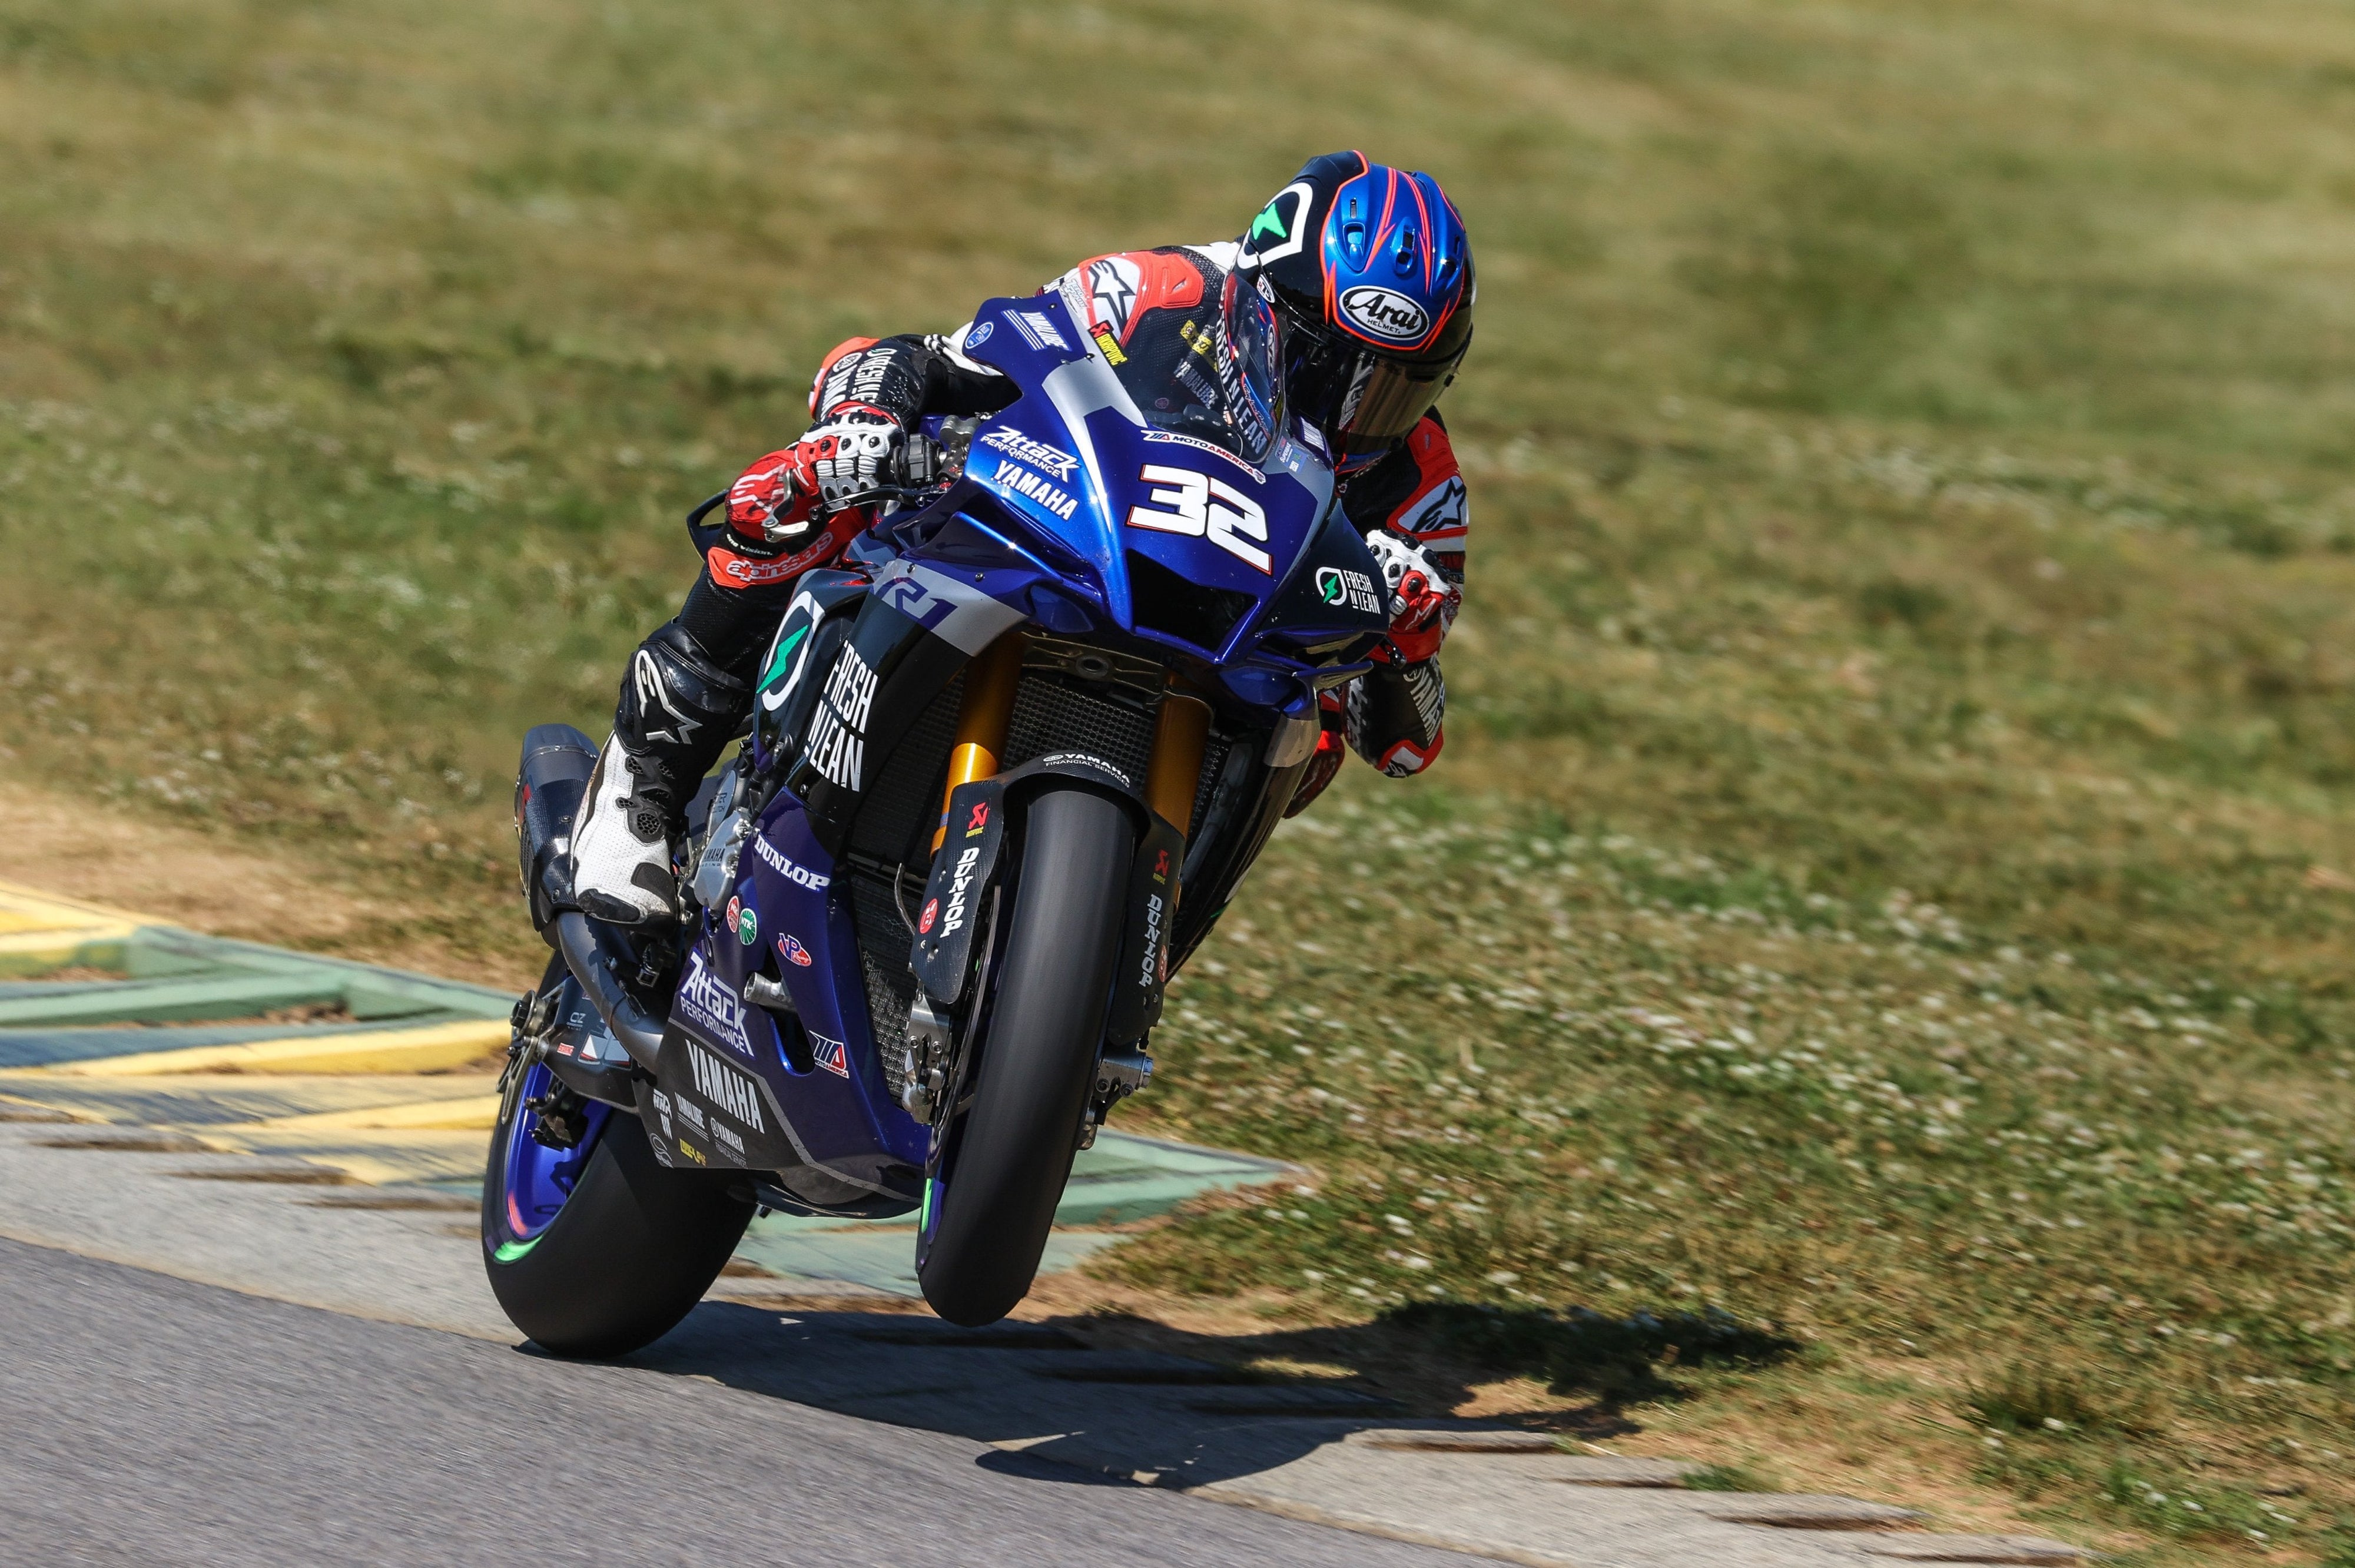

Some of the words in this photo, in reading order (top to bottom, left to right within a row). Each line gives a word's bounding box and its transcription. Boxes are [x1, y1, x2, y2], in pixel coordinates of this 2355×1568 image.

[1346, 294, 1421, 330] Arai
[1368, 319, 1401, 334] HELMET
[854, 356, 891, 386] FRESH
[1233, 396, 1267, 455] LEAN
[980, 435, 1062, 478] PERFORMANCE
[986, 425, 1080, 483] Attack
[1173, 436, 1254, 474] MOTOAMERICA
[993, 460, 1079, 521] YAMAHA
[1127, 464, 1273, 576] 32
[1343, 569, 1374, 593] FRESH
[1349, 589, 1358, 606] N
[1357, 591, 1381, 614] LEAN
[824, 639, 878, 734] FRESH
[809, 711, 864, 792] LEAN
[1065, 754, 1130, 784] YAMAHA
[1095, 765, 1129, 788] SERVICES
[754, 834, 831, 891] DUNLOP
[940, 847, 980, 938] DUNLOP
[741, 917, 753, 930] NTK
[779, 933, 801, 961] VP
[1139, 894, 1163, 987] DUNLOP
[680, 995, 746, 1053] PERFORMANCE
[681, 951, 754, 1057] Attack
[685, 1038, 765, 1134] YAMAHA
[717, 1121, 745, 1155] YAMAHA
